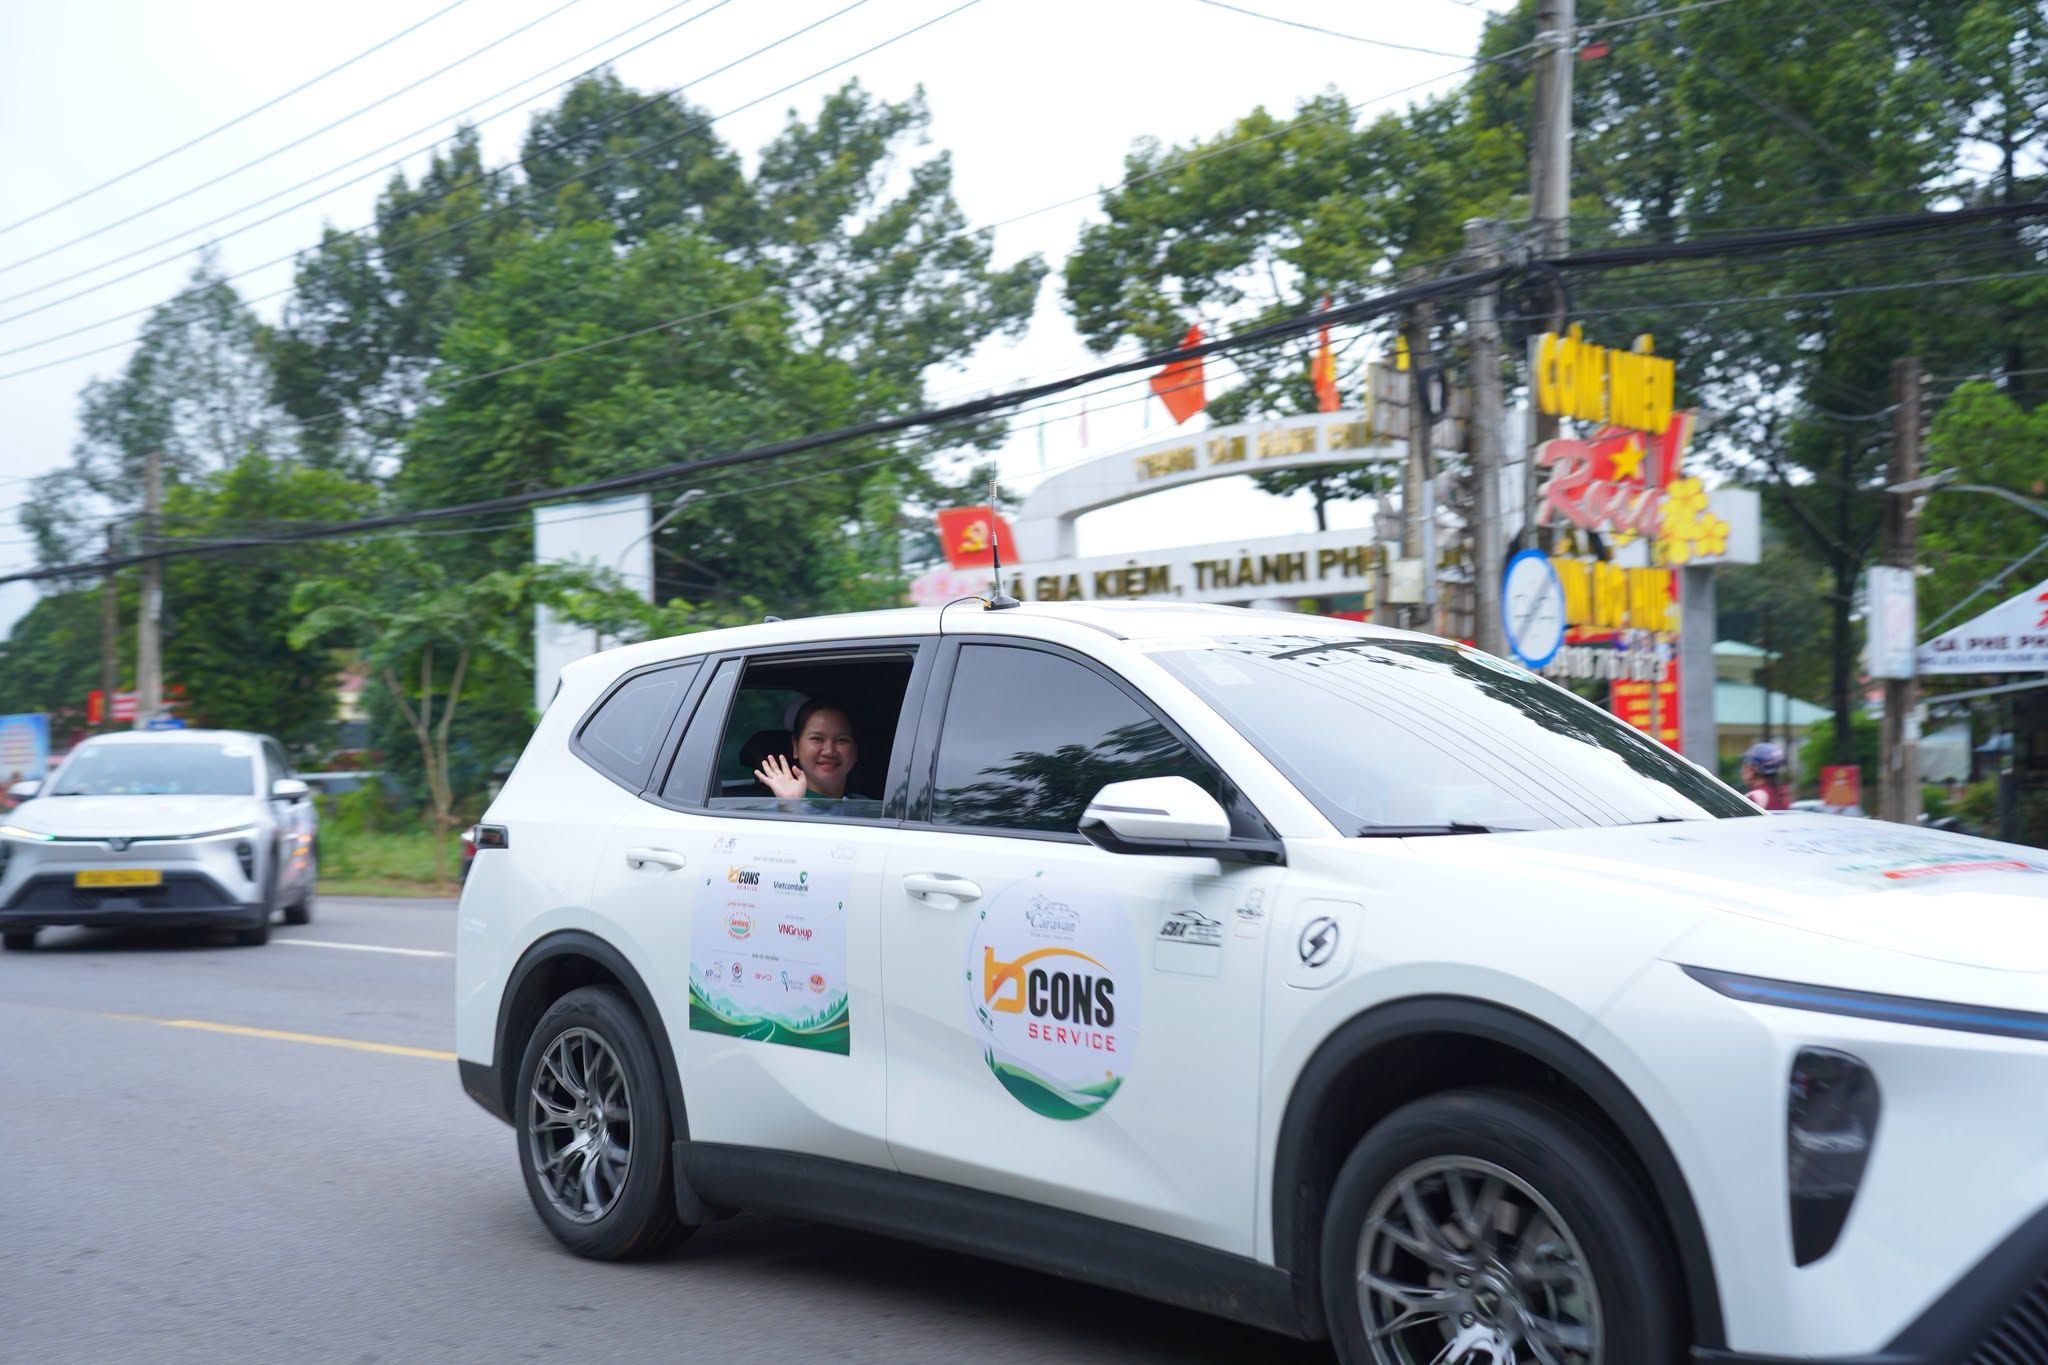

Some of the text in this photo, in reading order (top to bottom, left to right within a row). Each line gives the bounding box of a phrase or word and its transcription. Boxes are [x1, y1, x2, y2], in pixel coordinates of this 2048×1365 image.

[1192, 550, 1307, 591] THÀNH
[773, 880, 808, 892] Vietcombank
[778, 923, 813, 941] VNGroup
[1028, 1022, 1116, 1052] SERVICE
